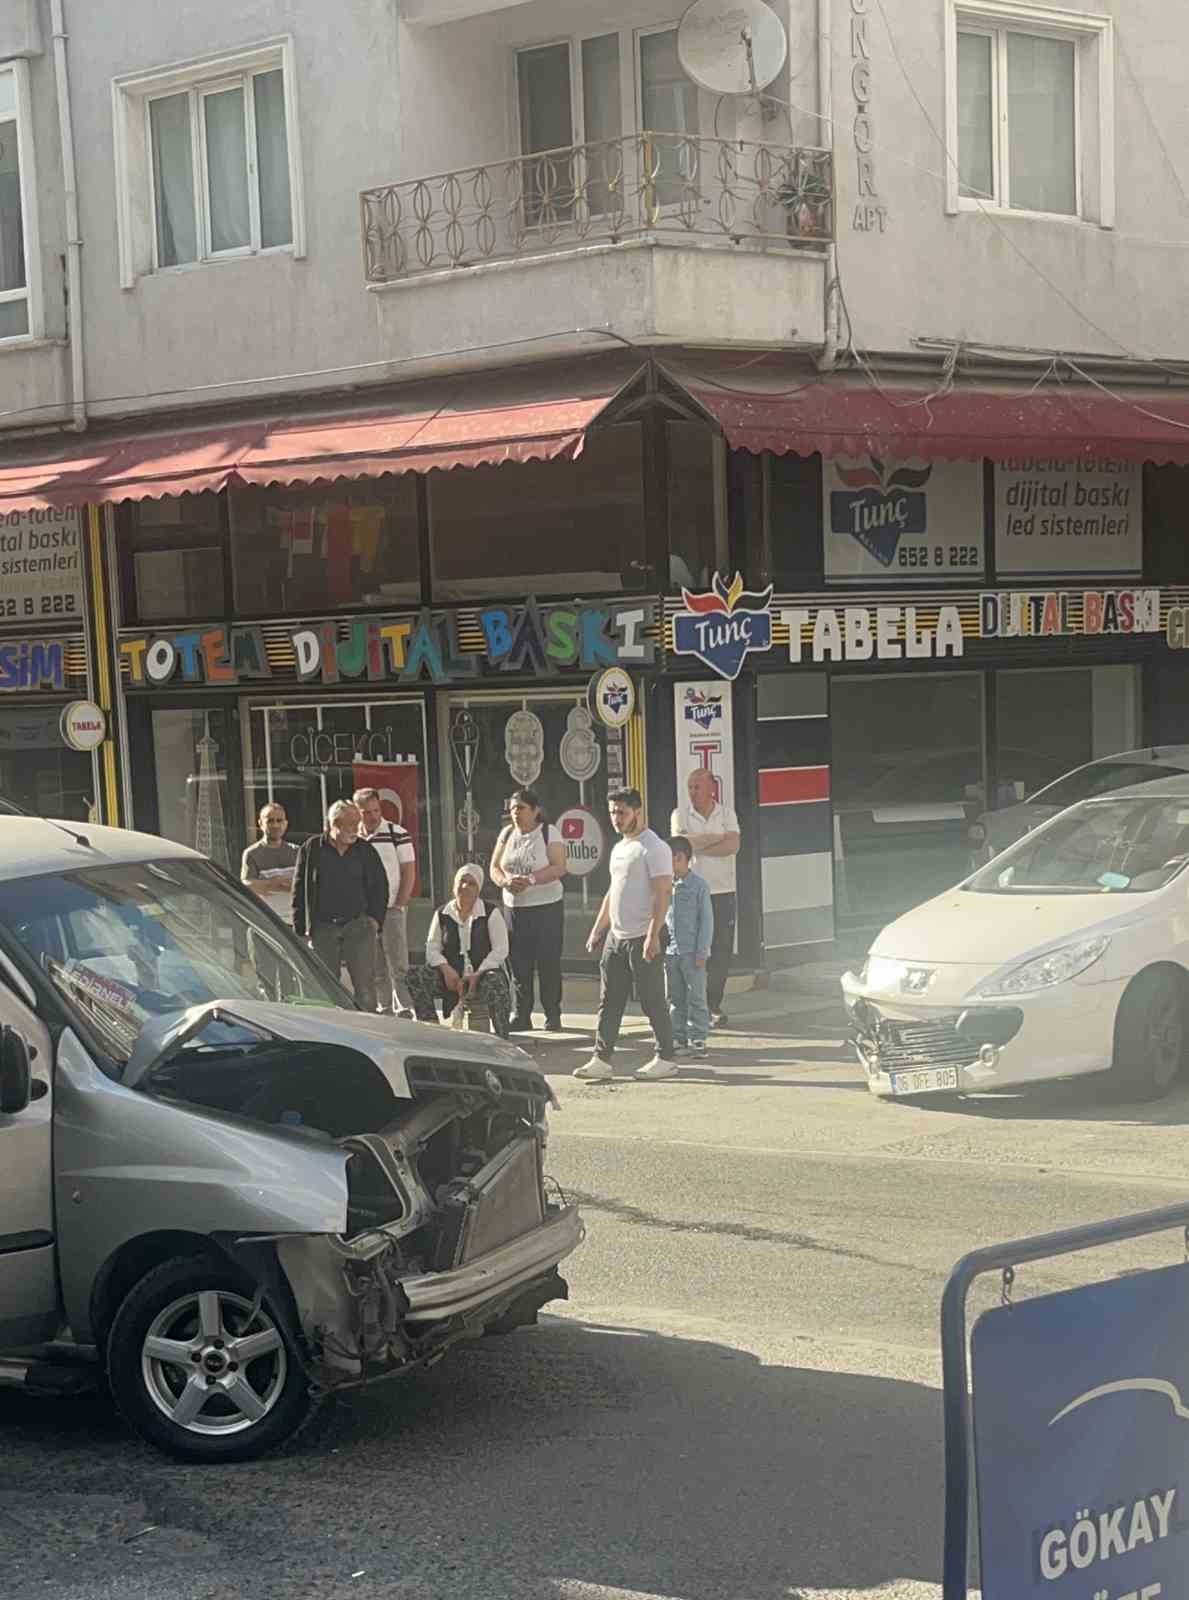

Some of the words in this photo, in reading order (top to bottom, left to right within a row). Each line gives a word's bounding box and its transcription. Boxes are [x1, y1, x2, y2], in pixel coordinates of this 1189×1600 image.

[1006, 480, 1068, 512] dijital
[1074, 481, 1129, 507] baskı
[848, 497, 909, 534] Tunç
[1006, 513, 1035, 536] led
[1040, 513, 1129, 537] sistemleri
[29, 527, 77, 550] baskı
[1, 552, 78, 575] sistemleri
[898, 546, 928, 567] 652
[934, 546, 944, 566] 8
[949, 546, 979, 567] 222
[23, 597, 34, 616] 8
[41, 594, 76, 614] 222
[1083, 590, 1160, 635] BASKI
[119, 626, 268, 684] TOTEM
[480, 602, 648, 675] BASKI
[694, 616, 753, 652] Tunç
[781, 606, 964, 664] TABELA
[935, 1070, 955, 1088] 805
[1039, 1489, 1176, 1580] GÖKAY
